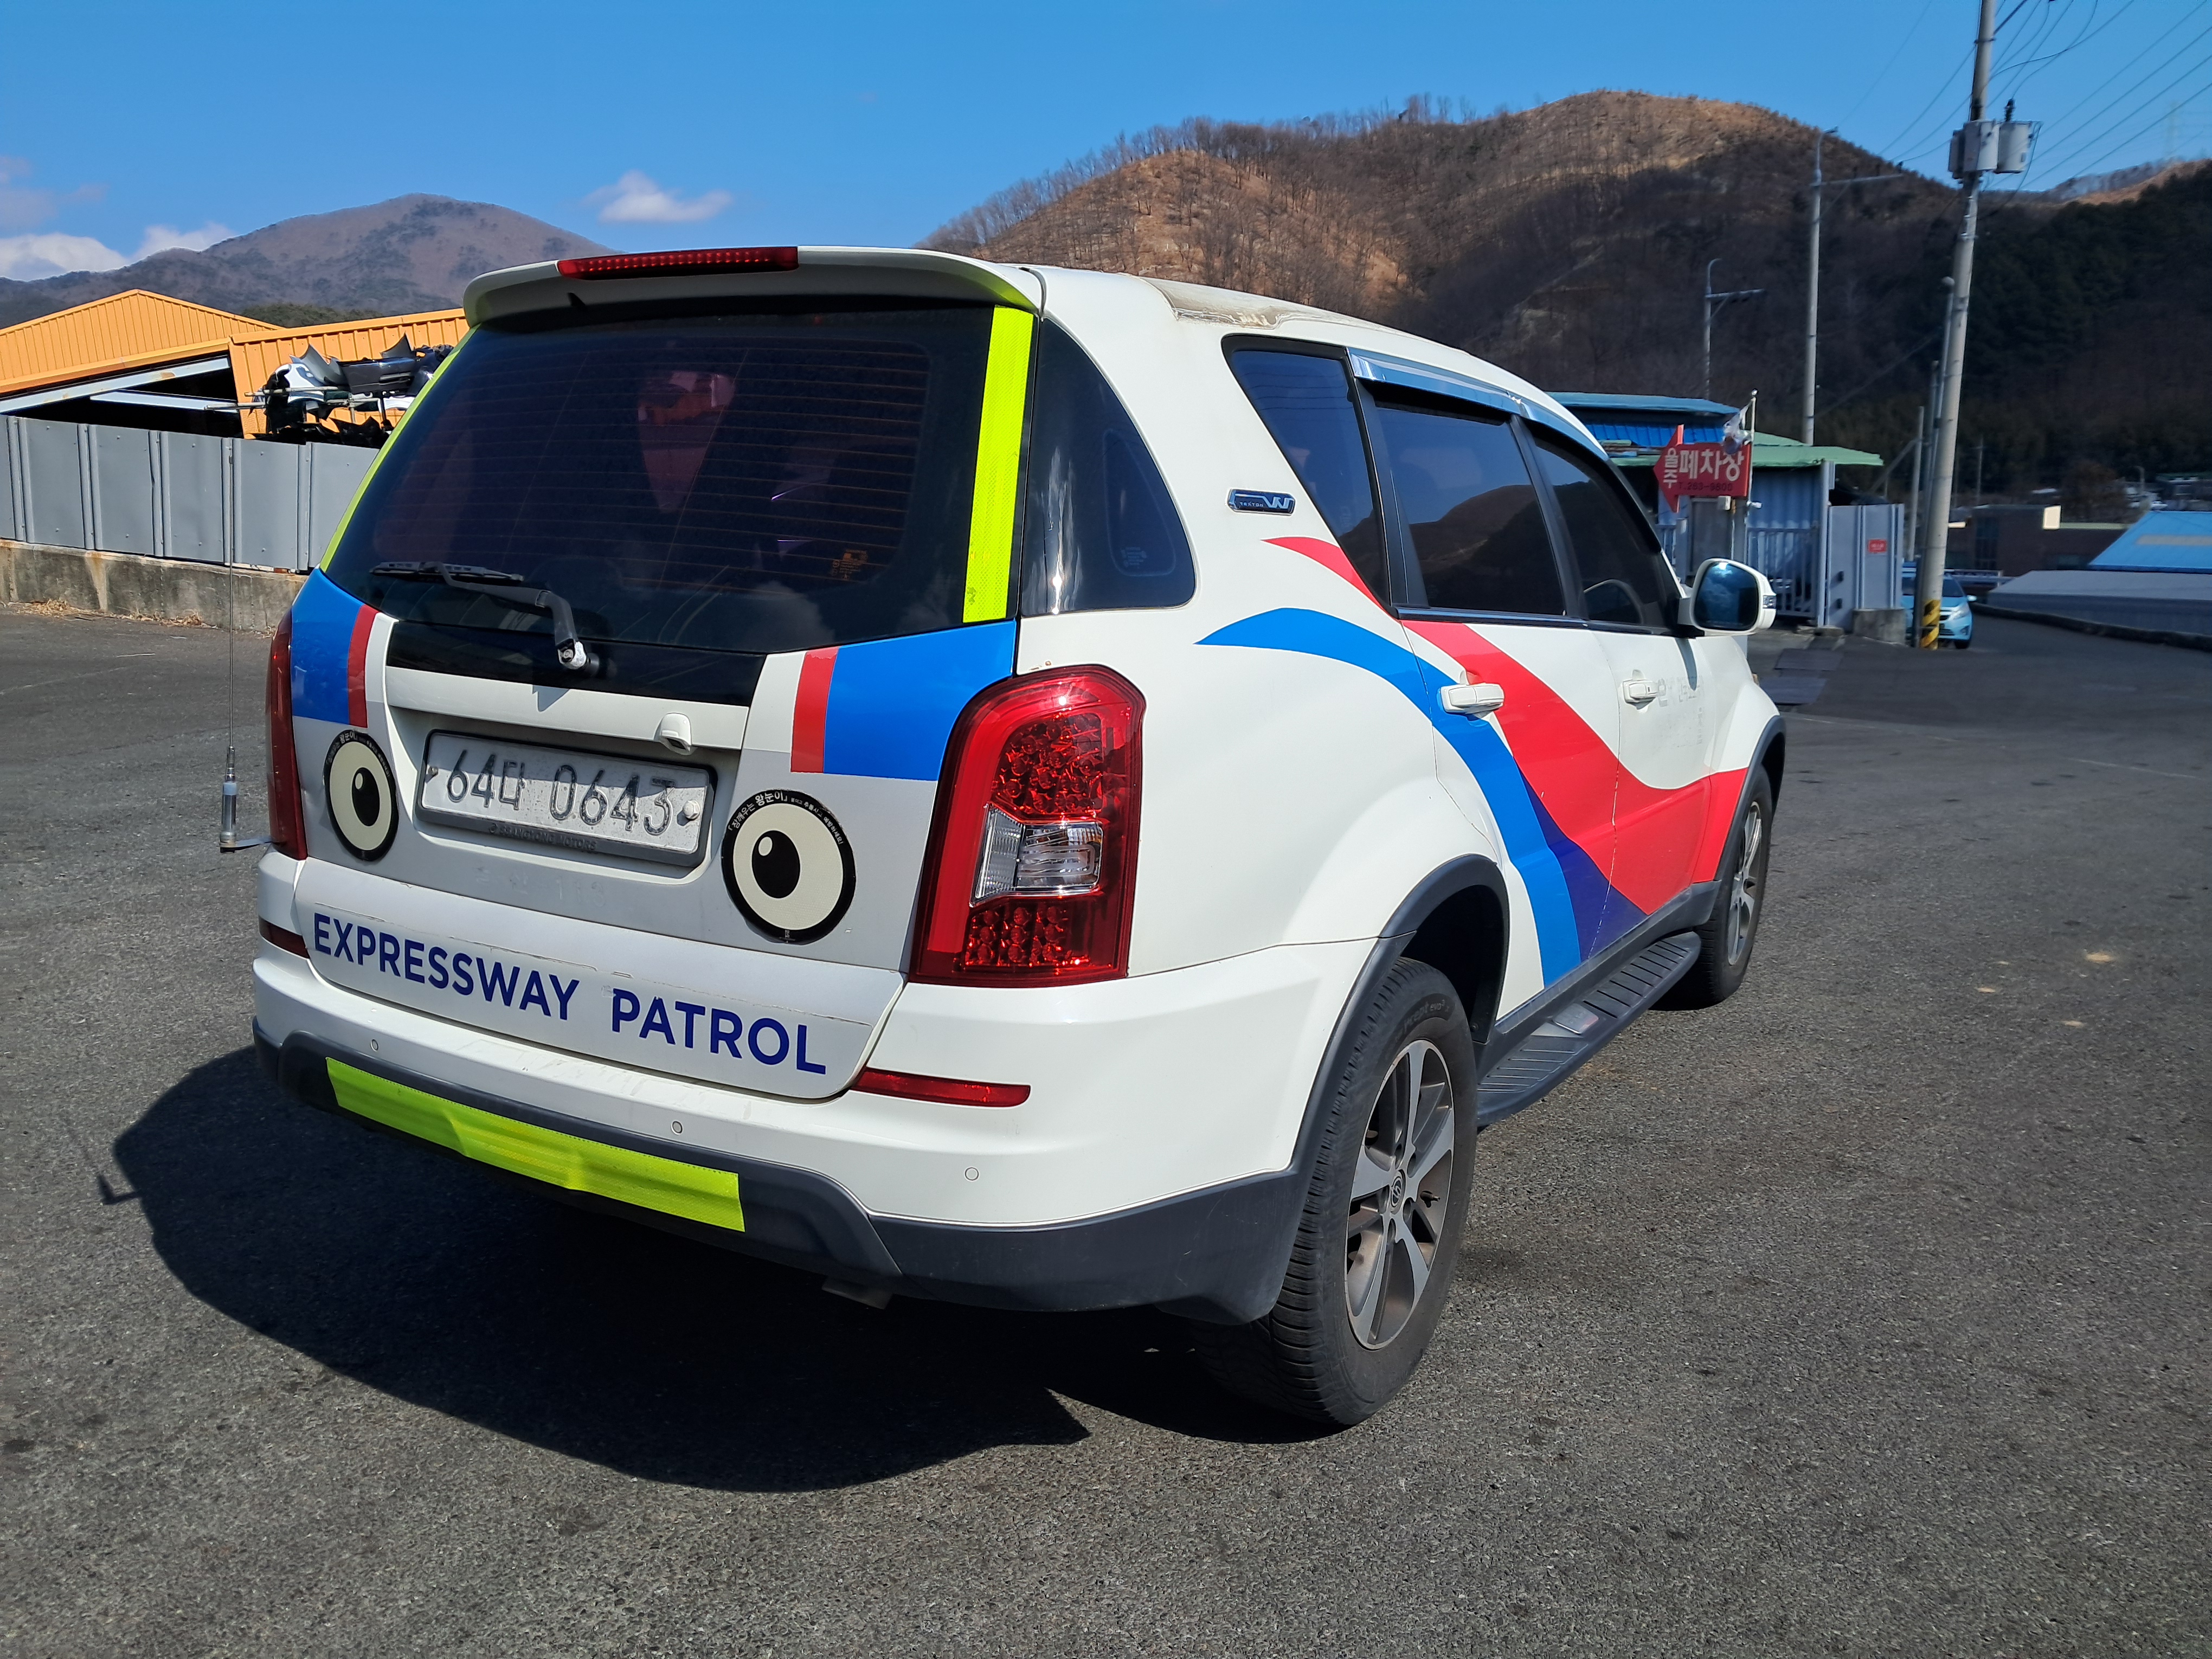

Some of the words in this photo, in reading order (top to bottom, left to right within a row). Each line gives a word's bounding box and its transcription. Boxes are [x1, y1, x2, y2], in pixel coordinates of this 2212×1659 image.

[1679, 448, 1745, 481] 폐차장
[549, 763, 673, 837] 0643
[314, 912, 580, 1020] EXPRESSWAY
[612, 988, 826, 1075] PATROL
